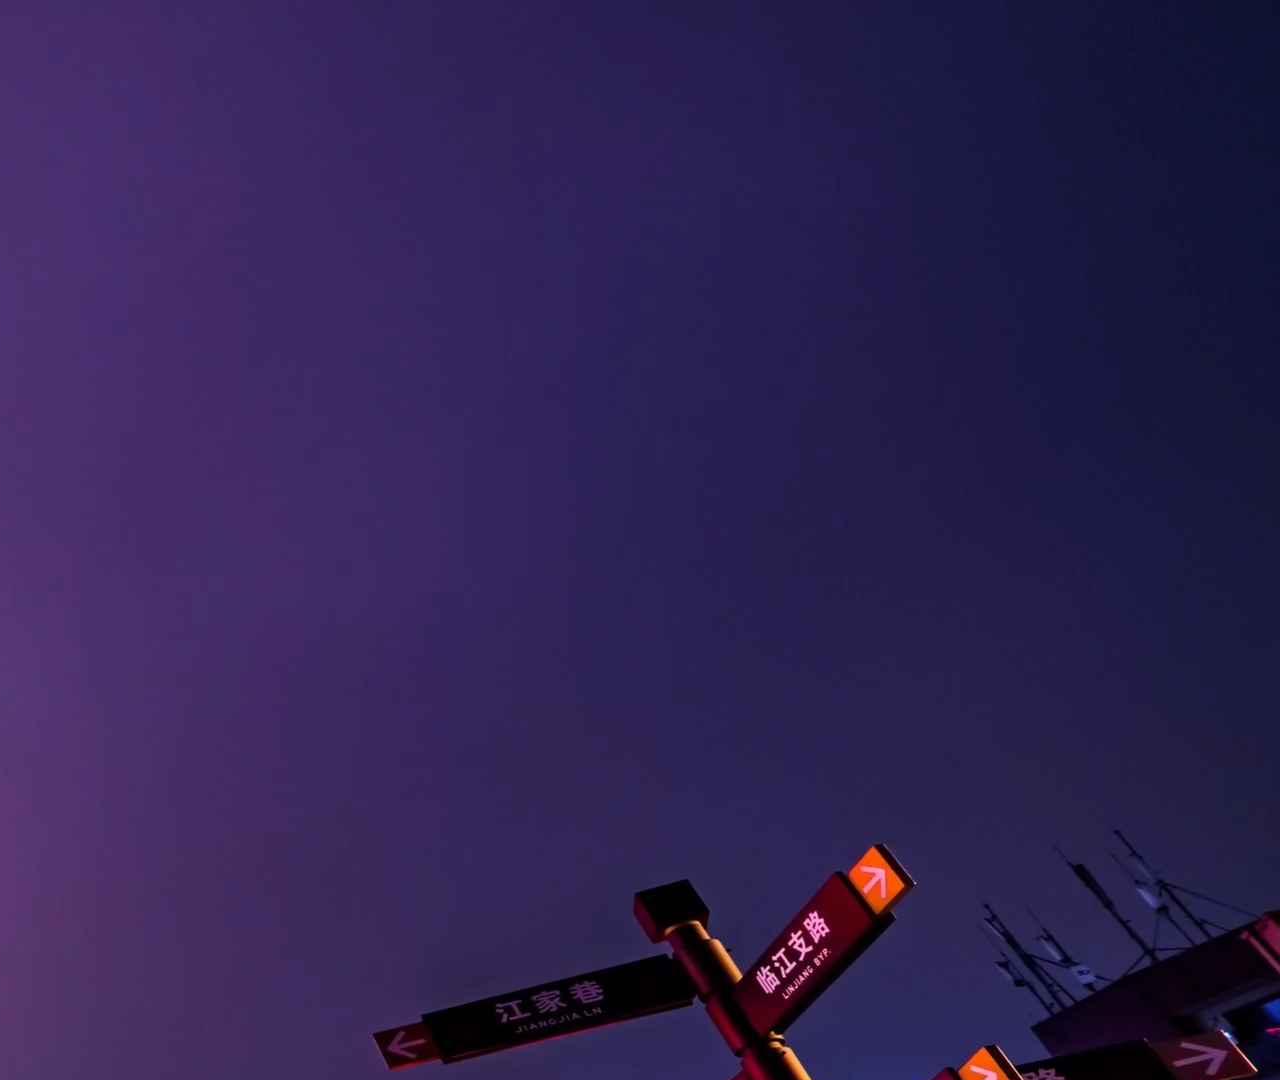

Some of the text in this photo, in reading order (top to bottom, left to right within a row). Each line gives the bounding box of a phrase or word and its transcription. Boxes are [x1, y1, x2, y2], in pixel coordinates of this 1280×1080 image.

[756, 911, 830, 994] 临江支路
[782, 948, 832, 999] LINJIANG BYP.
[495, 980, 604, 1023] 江家巷
[516, 1006, 607, 1033] JIANGJIA LN.
